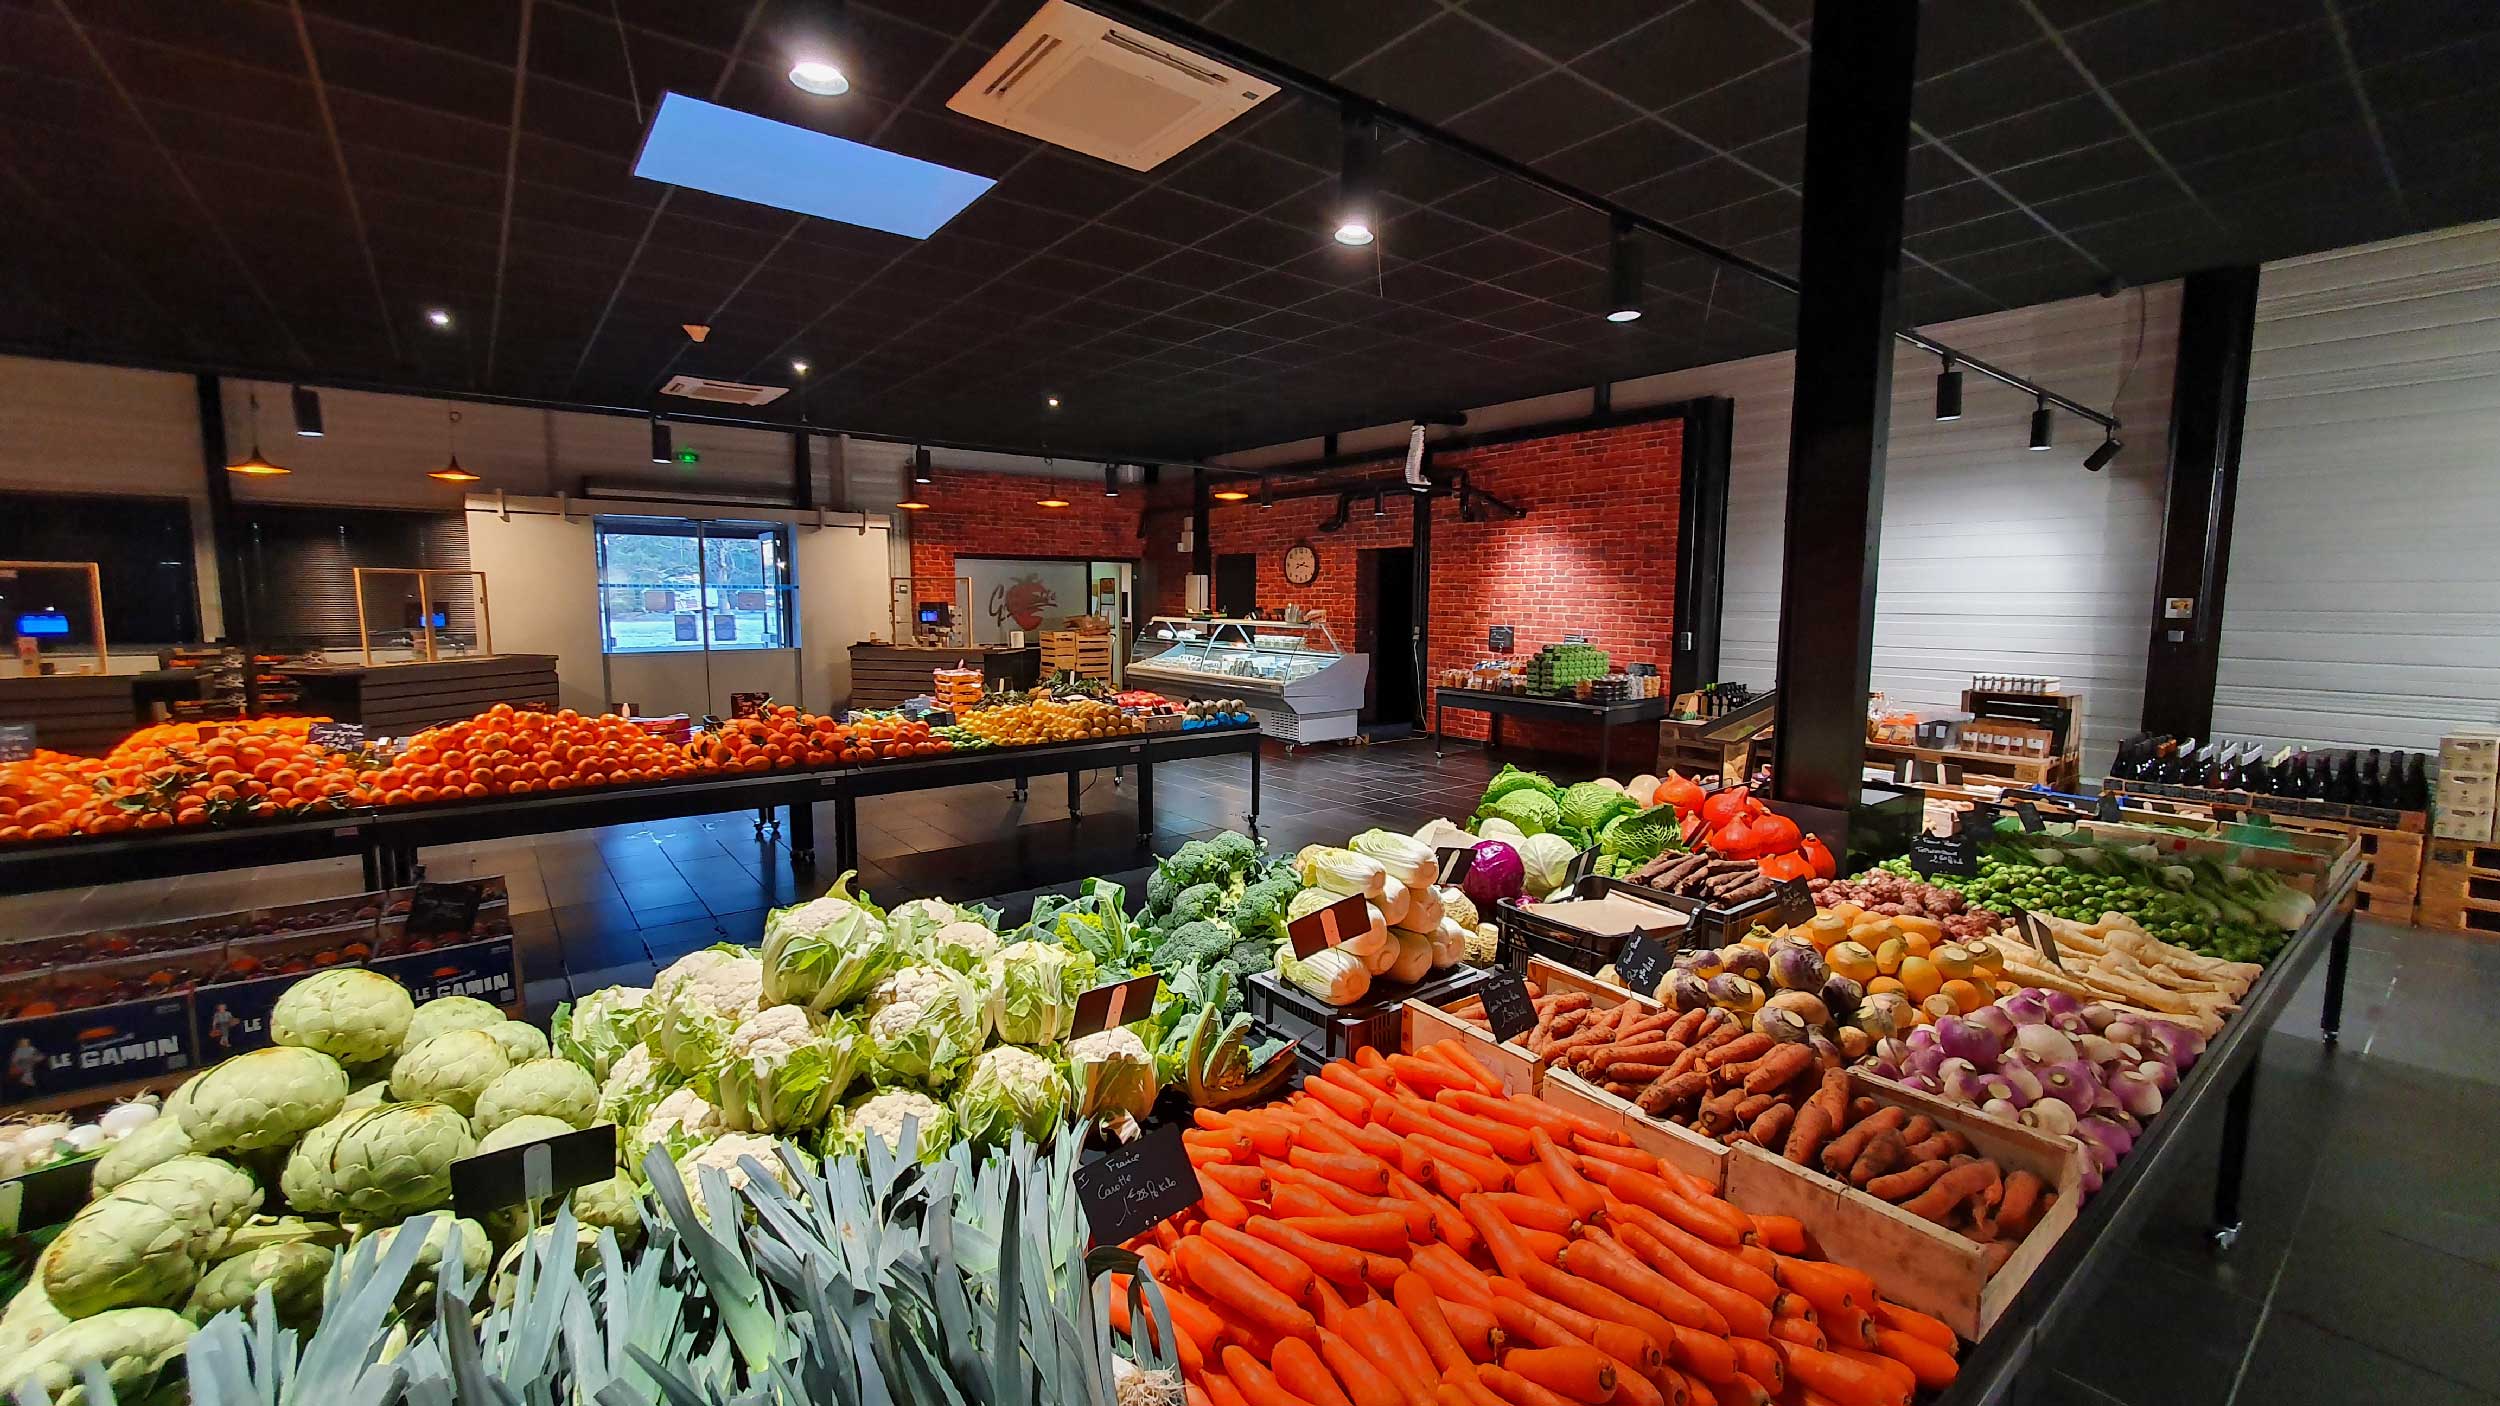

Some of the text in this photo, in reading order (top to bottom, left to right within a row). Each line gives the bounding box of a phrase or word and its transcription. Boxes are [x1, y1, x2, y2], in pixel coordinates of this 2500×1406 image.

[415, 986, 431, 1001] LE
[436, 972, 509, 999] GAMIN
[244, 1018, 262, 1033] LE
[50, 1052, 72, 1070] LE
[79, 1035, 179, 1069] GAMIN
